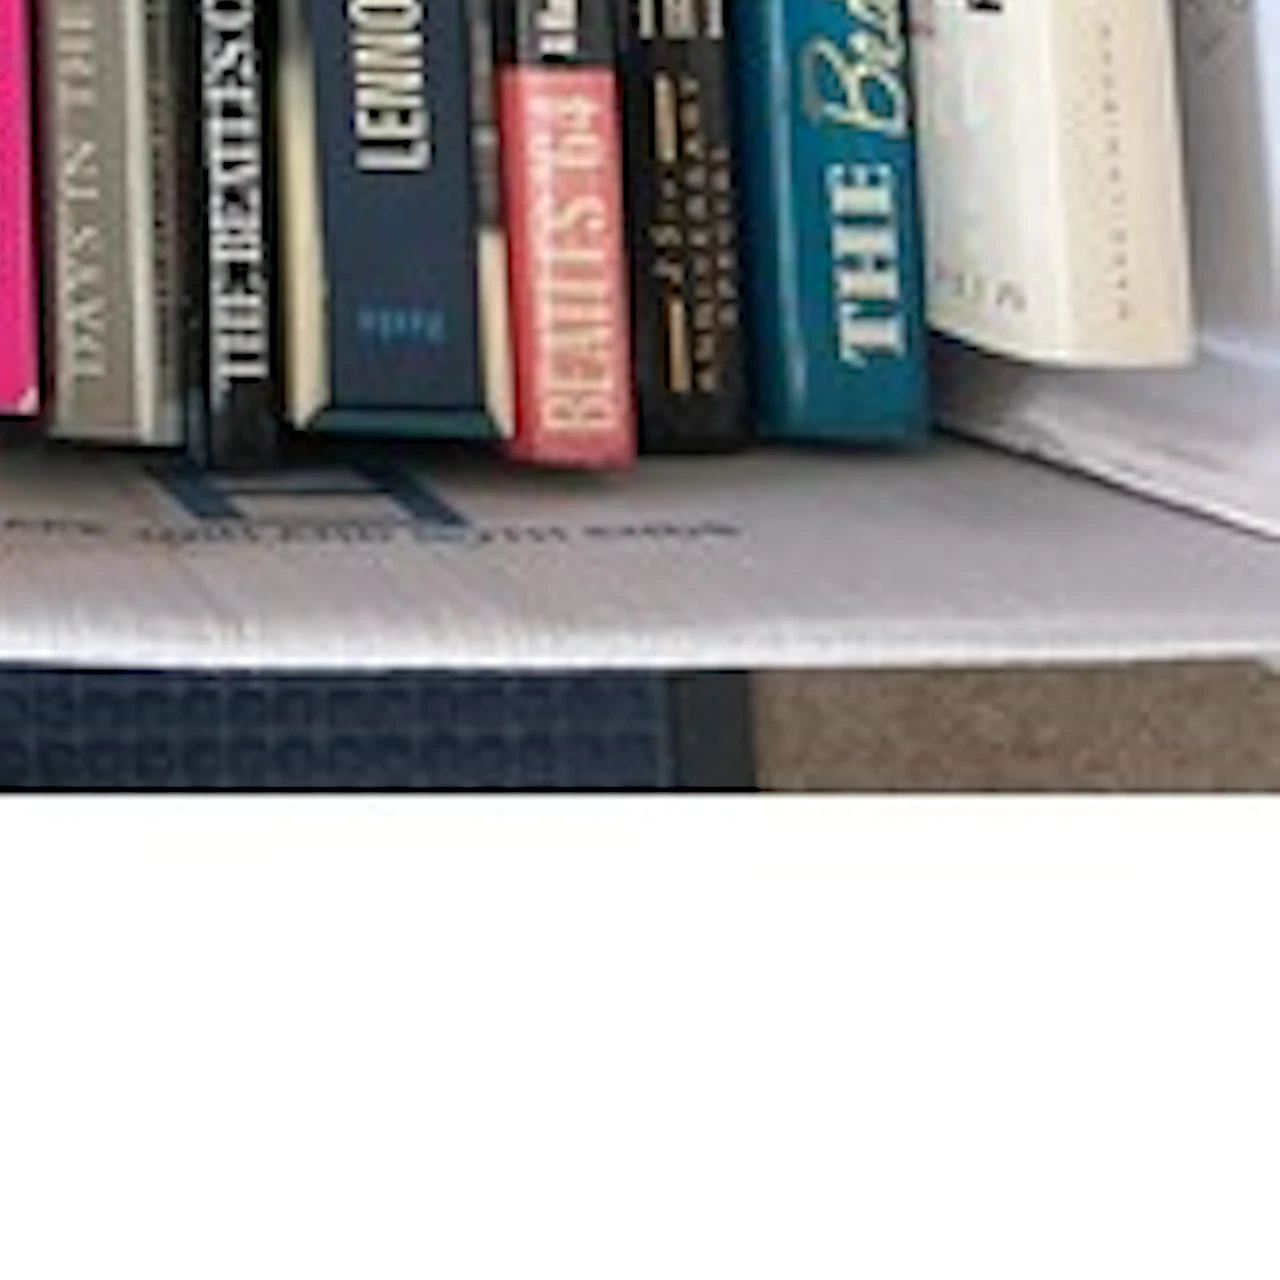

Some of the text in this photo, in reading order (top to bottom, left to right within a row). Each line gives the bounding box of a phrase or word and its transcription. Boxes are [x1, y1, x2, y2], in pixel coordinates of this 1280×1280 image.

[54, 17, 97, 107] THE
[58, 141, 100, 202] IN
[201, 36, 263, 266] BEATLES
[59, 223, 107, 380] DAYS
[208, 270, 268, 383] THE
[538, 196, 617, 432] BEATLES
[825, 164, 906, 367] THE
